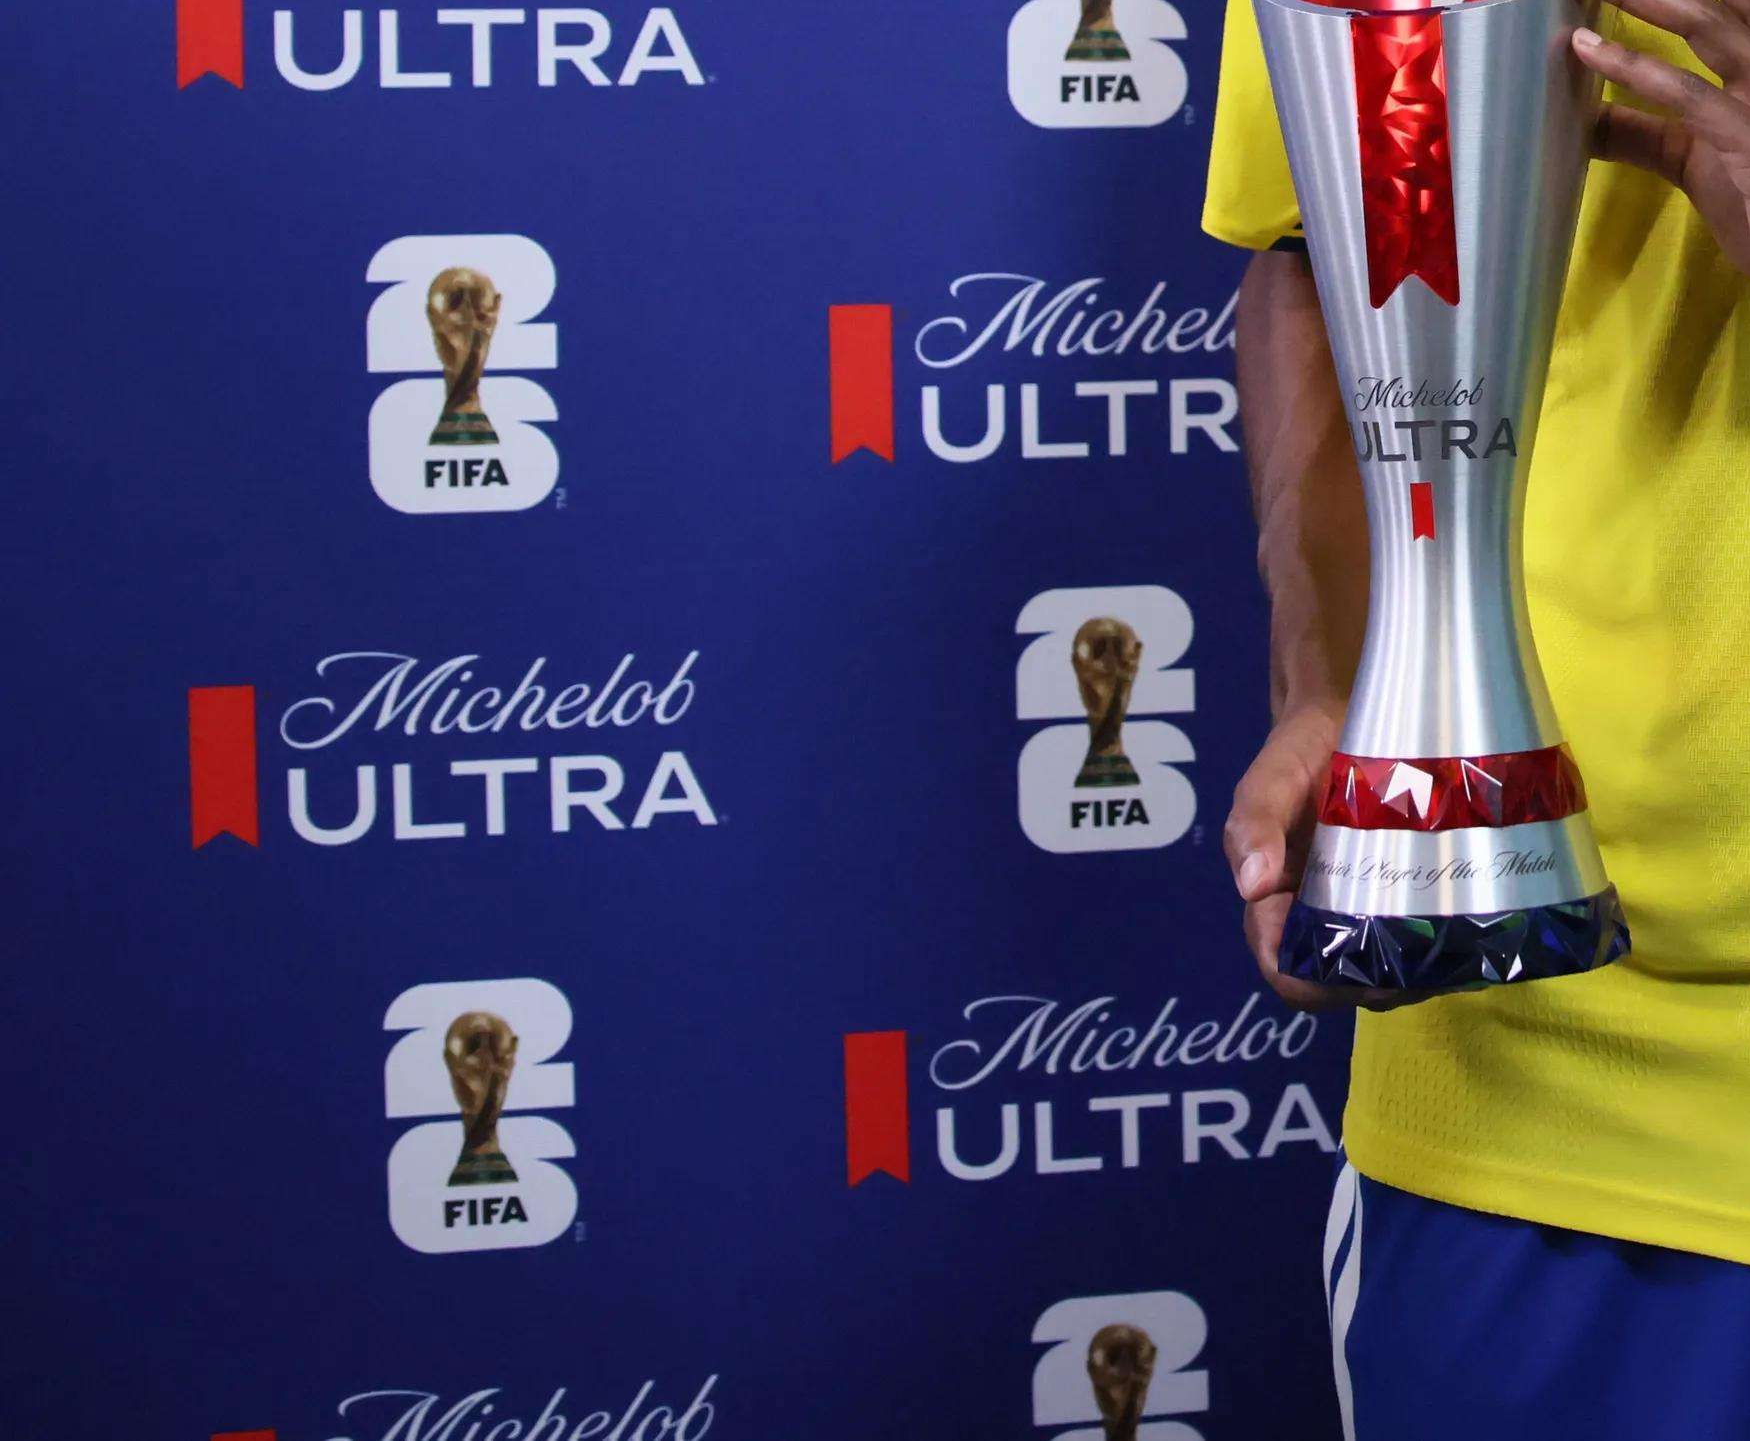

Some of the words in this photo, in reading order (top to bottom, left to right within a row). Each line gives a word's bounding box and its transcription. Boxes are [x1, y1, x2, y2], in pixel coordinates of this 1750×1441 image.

[274, 8, 705, 90] ULTRA
[1061, 74, 1140, 103] FIFA
[915, 273, 1237, 369] Michel
[921, 379, 1238, 463] ULTR
[1354, 376, 1486, 411] Michelob
[425, 458, 509, 488] FIFA
[280, 651, 698, 749] Michelob
[288, 752, 717, 845] ULTRA
[1071, 798, 1150, 829] FIFA
[936, 1083, 1337, 1180] ULTRA
[444, 1196, 528, 1228] FIFA
